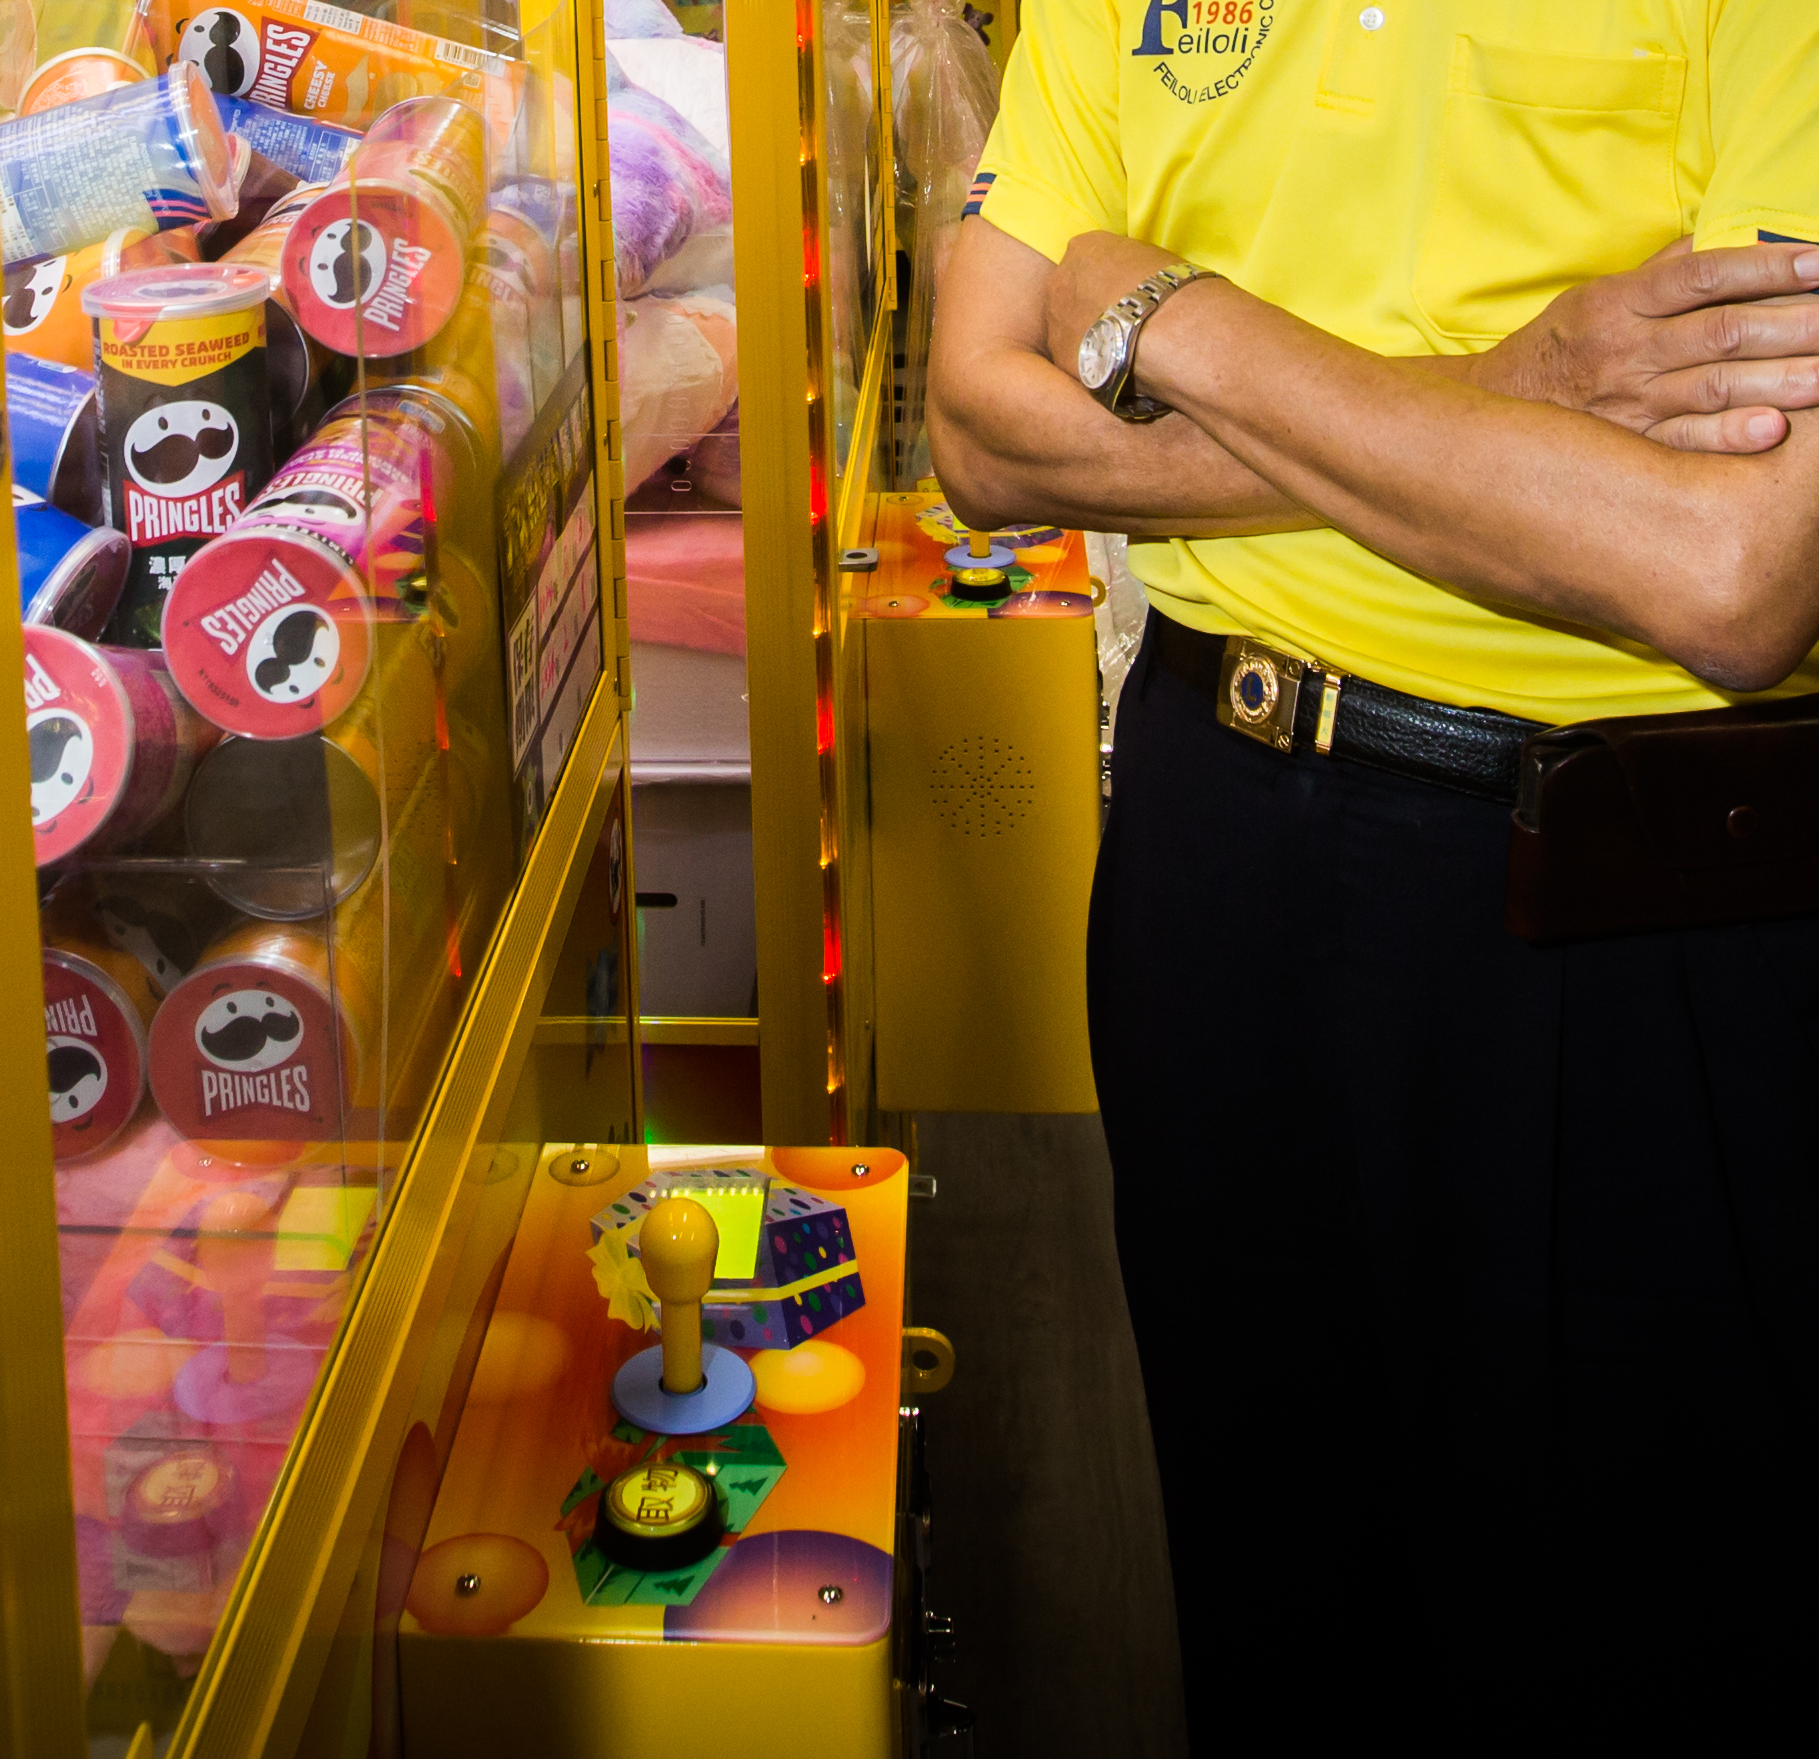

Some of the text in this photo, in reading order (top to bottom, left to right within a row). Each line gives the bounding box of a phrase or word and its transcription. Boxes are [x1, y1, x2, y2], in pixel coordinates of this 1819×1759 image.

[1192, 0, 1255, 25] 1986
[249, 24, 311, 108] RINGLES
[303, 60, 328, 110] CHEESY
[317, 71, 336, 108] CHEESE
[364, 237, 432, 332] PRINGLES
[103, 332, 250, 359] ROASTED SEAWEED
[122, 351, 232, 370] IN EVERY CRUNCH
[128, 481, 242, 542] PRINGLES
[201, 556, 304, 655] PRINGLES
[201, 1064, 311, 1117] PRINGLES
[638, 1465, 681, 1524] 取物
